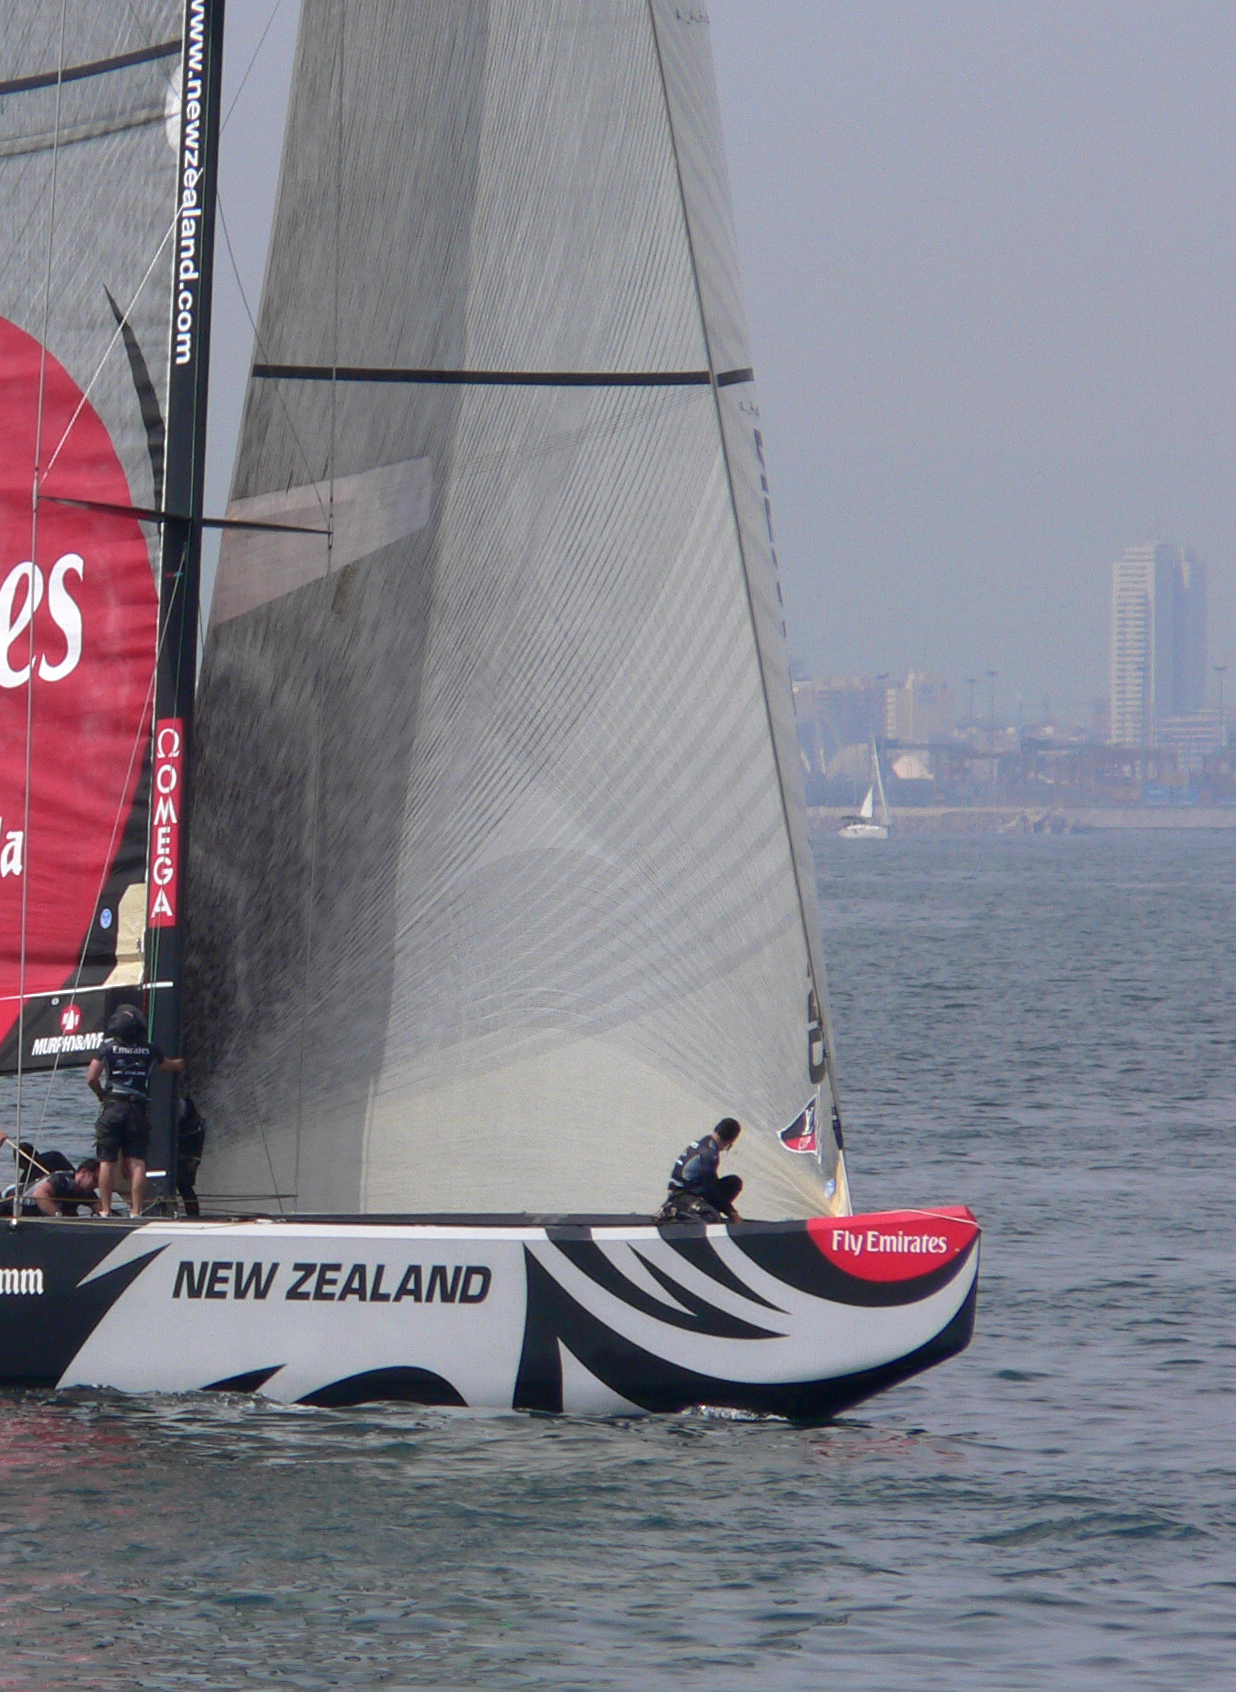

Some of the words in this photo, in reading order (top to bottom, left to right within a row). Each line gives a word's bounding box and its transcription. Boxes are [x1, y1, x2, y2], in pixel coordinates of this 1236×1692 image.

[151, 764, 178, 918] OMEGA
[832, 1229, 863, 1256] Fly
[866, 1230, 948, 1254] Emirates
[172, 1260, 280, 1300] NEW
[284, 1262, 492, 1304] ZEALAND
